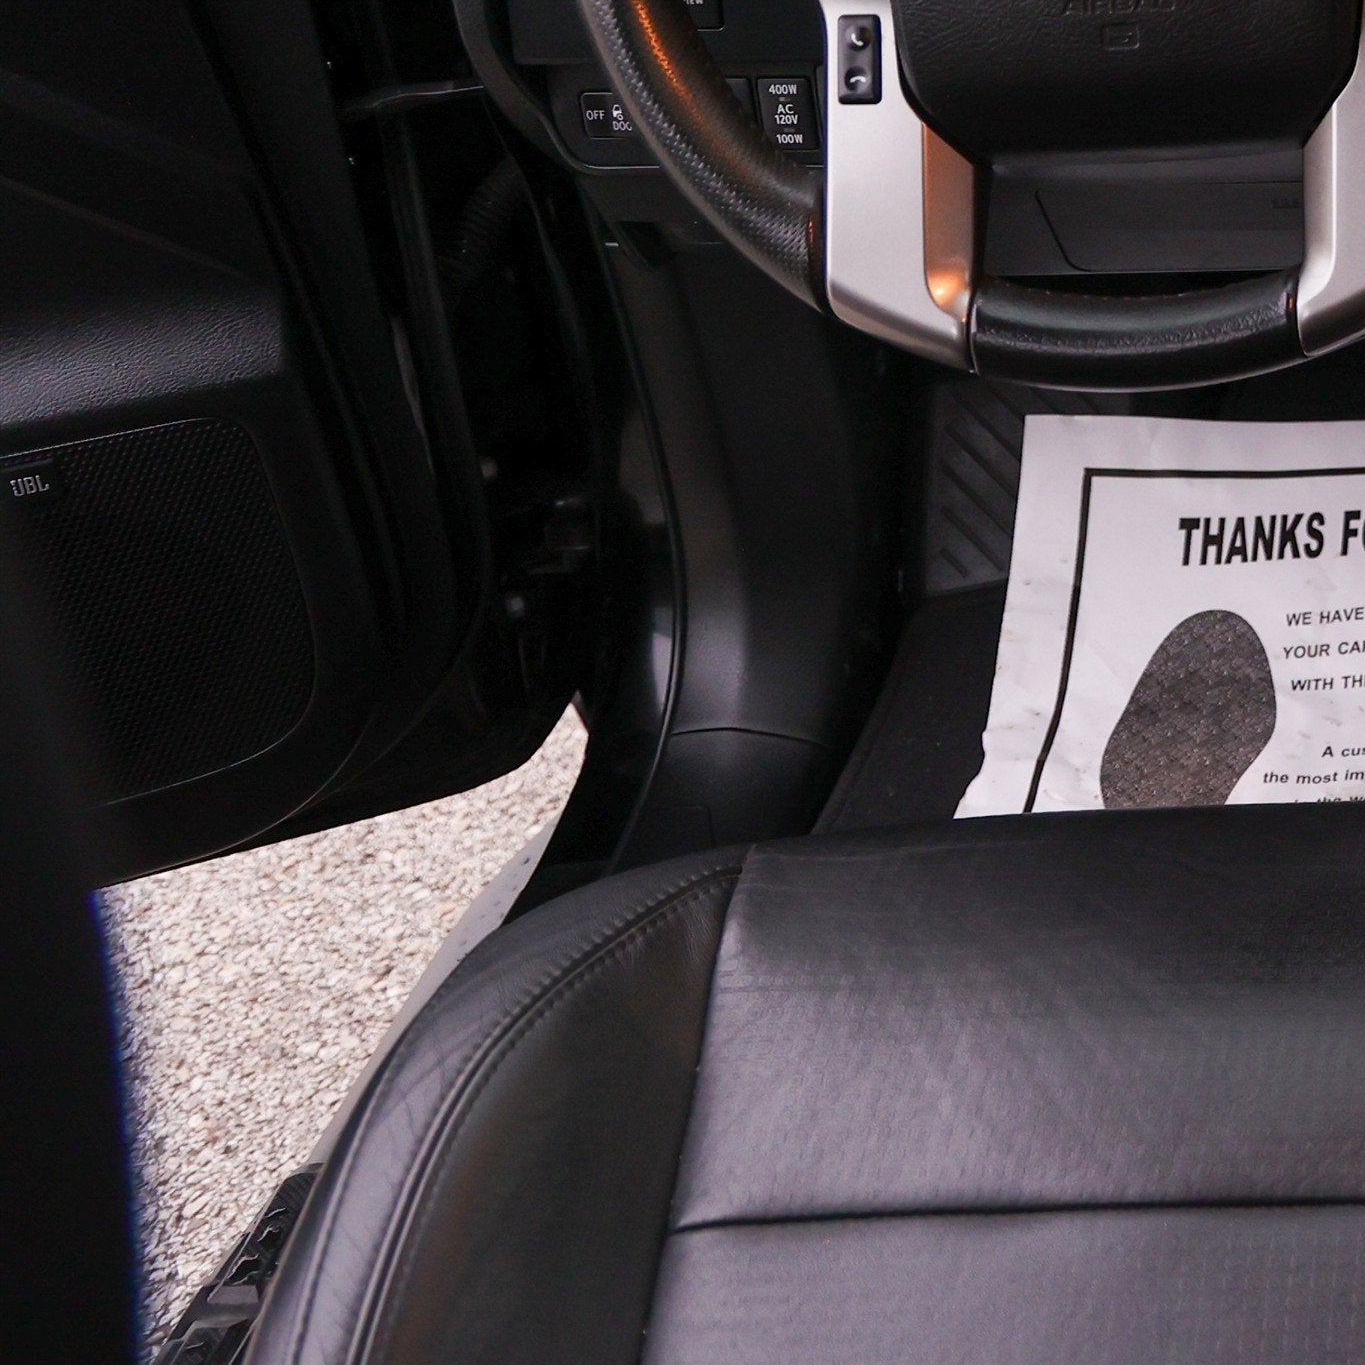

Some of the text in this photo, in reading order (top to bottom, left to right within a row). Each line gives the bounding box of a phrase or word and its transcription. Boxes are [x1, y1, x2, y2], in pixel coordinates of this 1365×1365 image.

[768, 84, 797, 95] 400W
[586, 110, 605, 121] OFF
[777, 104, 794, 115] AC
[774, 114, 798, 125] 120V
[776, 133, 803, 144] 100W
[10, 474, 50, 497] JBL
[1177, 510, 1325, 567] THANKS
[1286, 611, 1312, 627] WE
[1319, 607, 1365, 624] HAVE
[1283, 644, 1331, 660] YOUR
[1291, 677, 1334, 691] WITH
[1321, 745, 1334, 758] A
[1263, 772, 1289, 784] the
[1296, 772, 1337, 785] most
